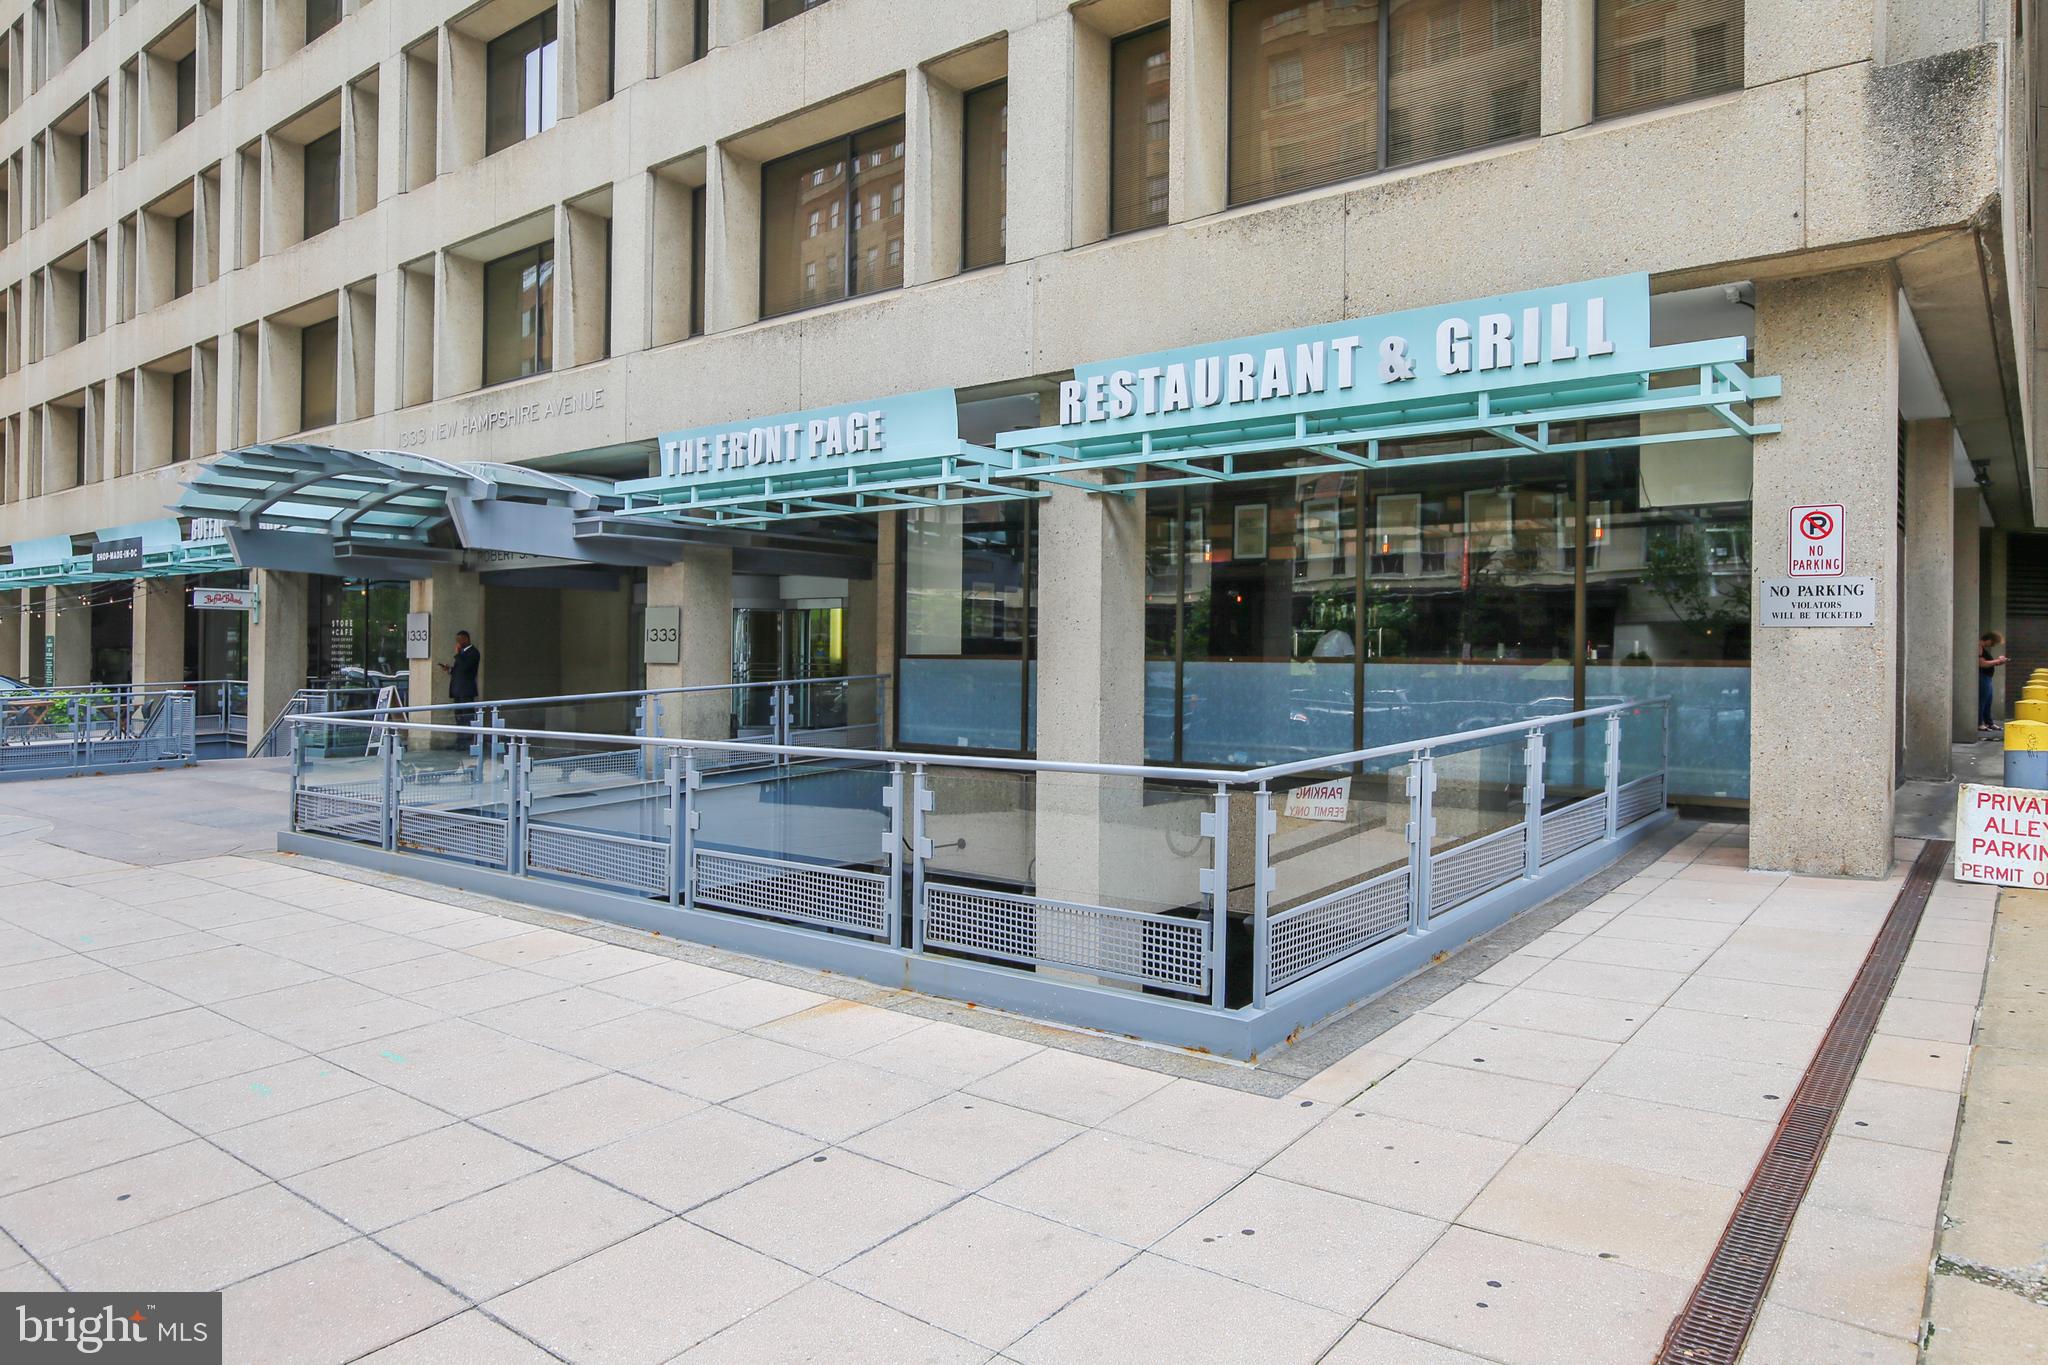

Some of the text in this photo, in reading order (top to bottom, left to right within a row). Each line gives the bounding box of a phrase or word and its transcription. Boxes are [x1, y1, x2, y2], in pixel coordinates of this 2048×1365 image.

[1059, 297, 1616, 426] RESTAURANT & GRILL
[399, 388, 605, 448] 1333 NEW HAMPSHIRE AVENUE
[665, 410, 887, 476] THE FRONT PAGE
[1809, 545, 1824, 556] NO
[1793, 559, 1840, 570] PARKING
[1770, 584, 1864, 597] NO PARKING
[1791, 601, 1842, 609] VIOLATORS
[1772, 611, 1862, 620] WILL BE TICKETED
[331, 619, 353, 627] STORE
[407, 630, 428, 642] 1333
[646, 628, 677, 642] 1333
[1961, 862, 2024, 883] PERMIT
